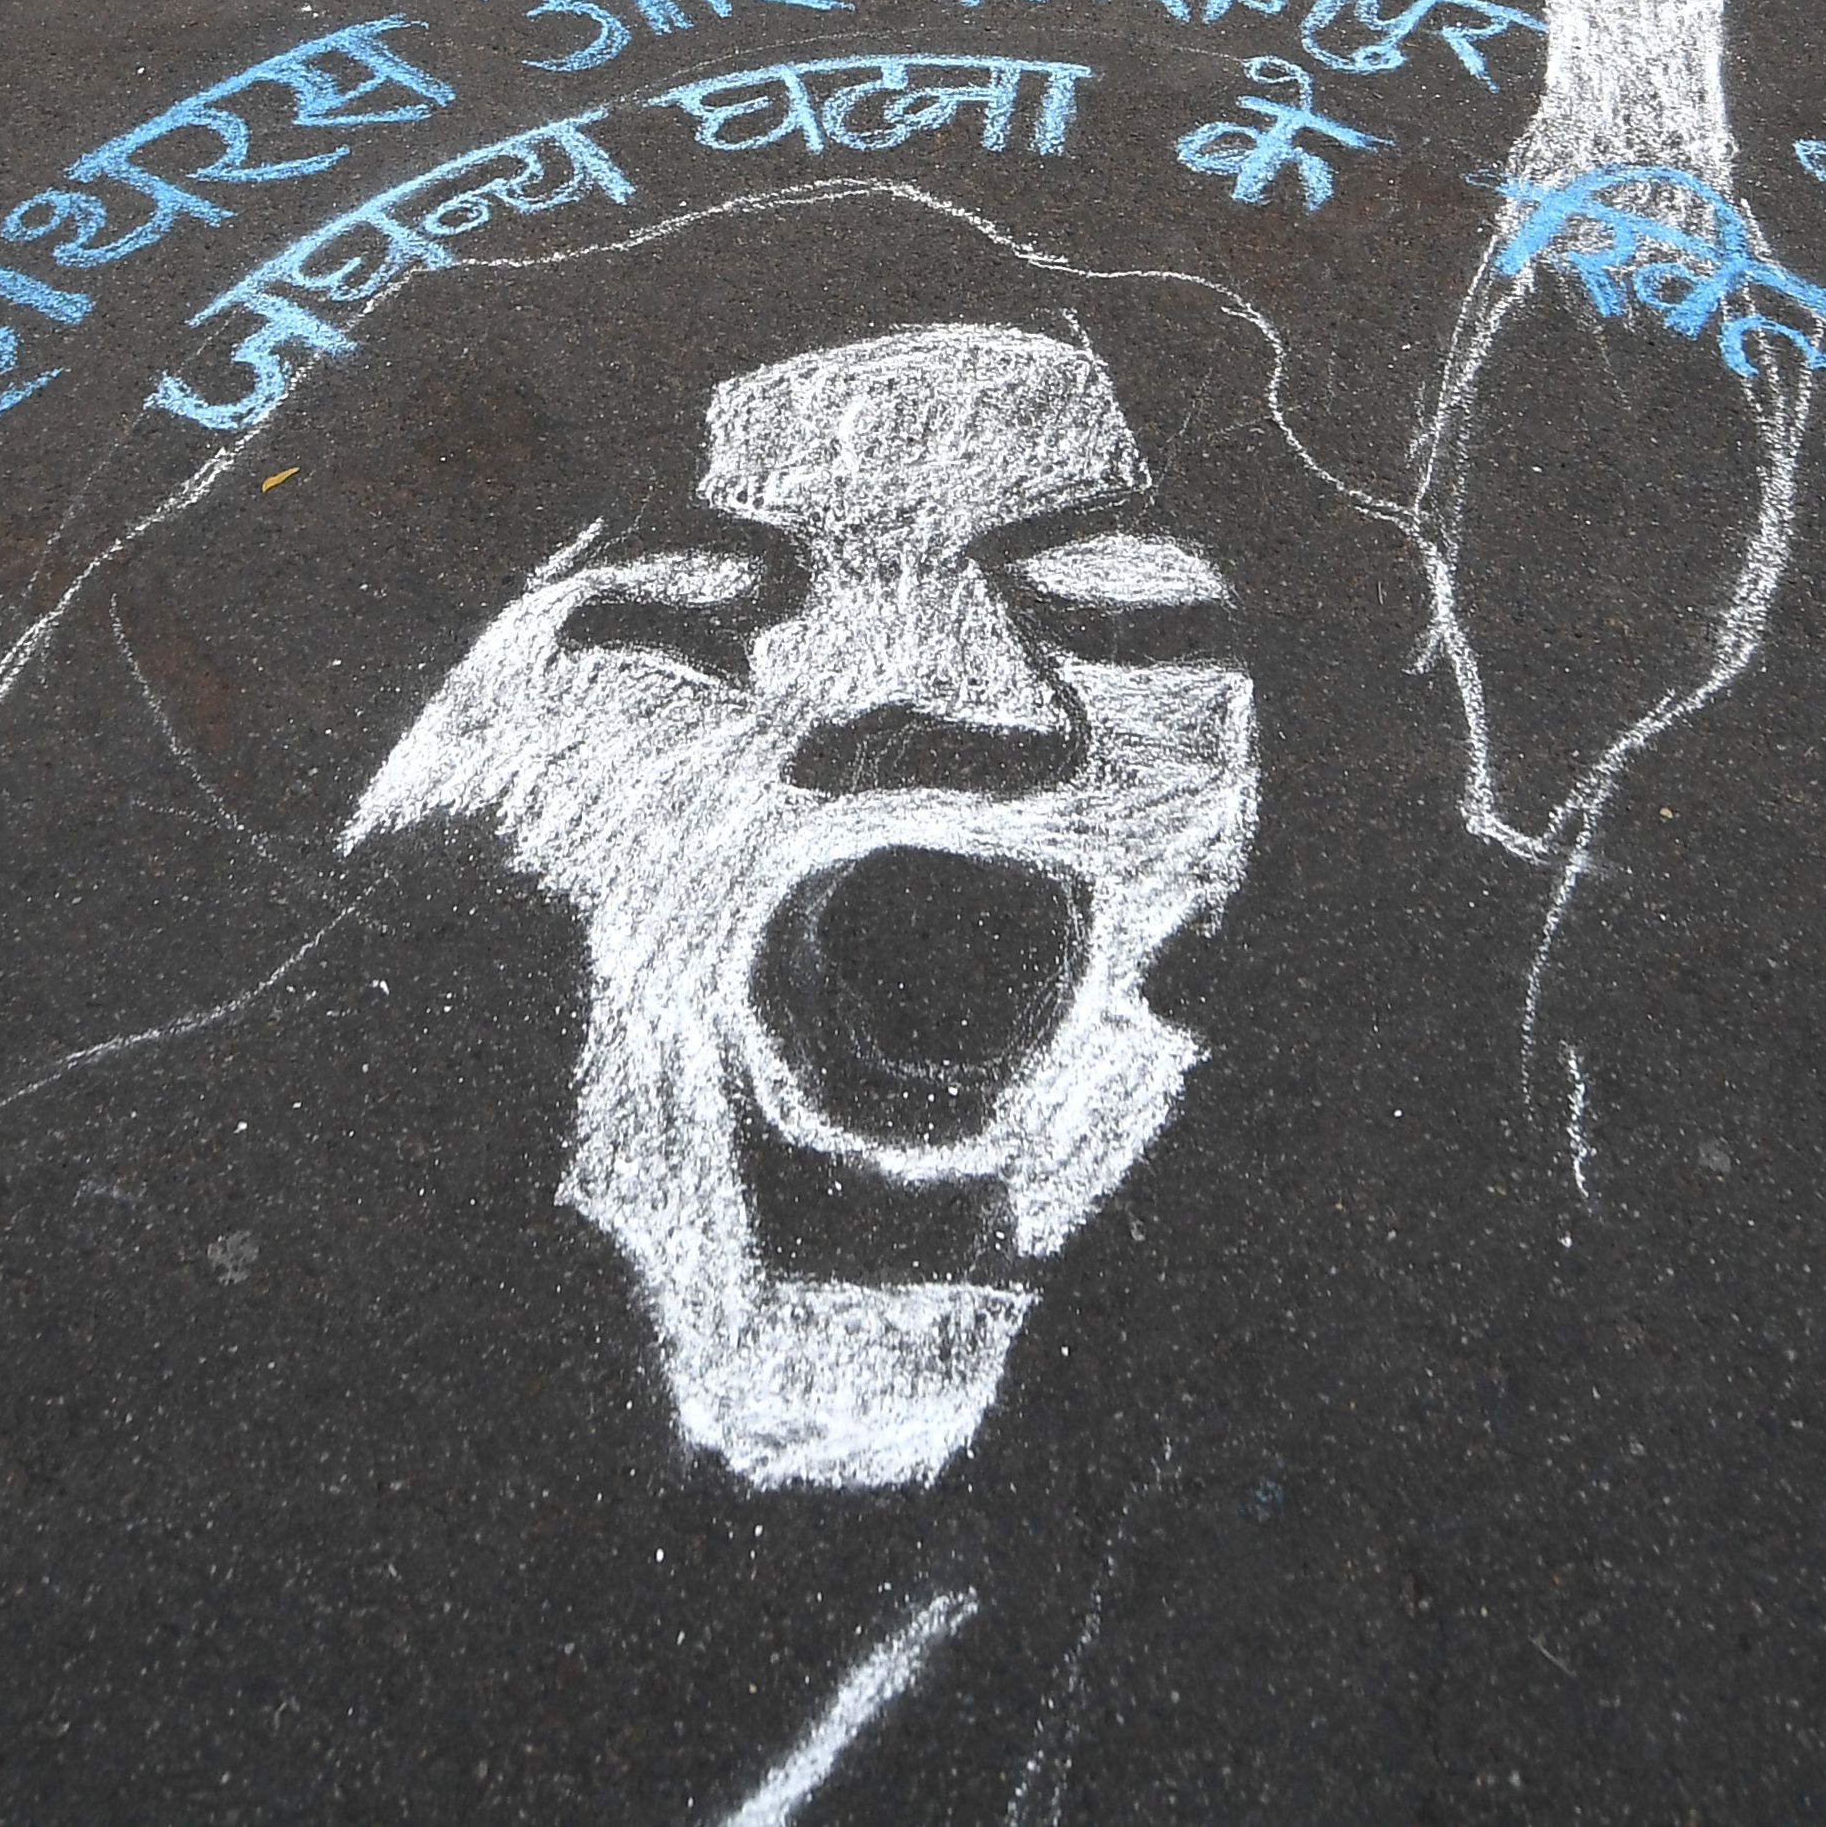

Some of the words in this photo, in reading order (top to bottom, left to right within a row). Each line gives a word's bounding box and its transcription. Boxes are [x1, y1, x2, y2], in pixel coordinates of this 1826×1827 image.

[143, 104, 639, 434] जघन्य
[651, 51, 1093, 157] घटना
[1173, 53, 1395, 212] के
